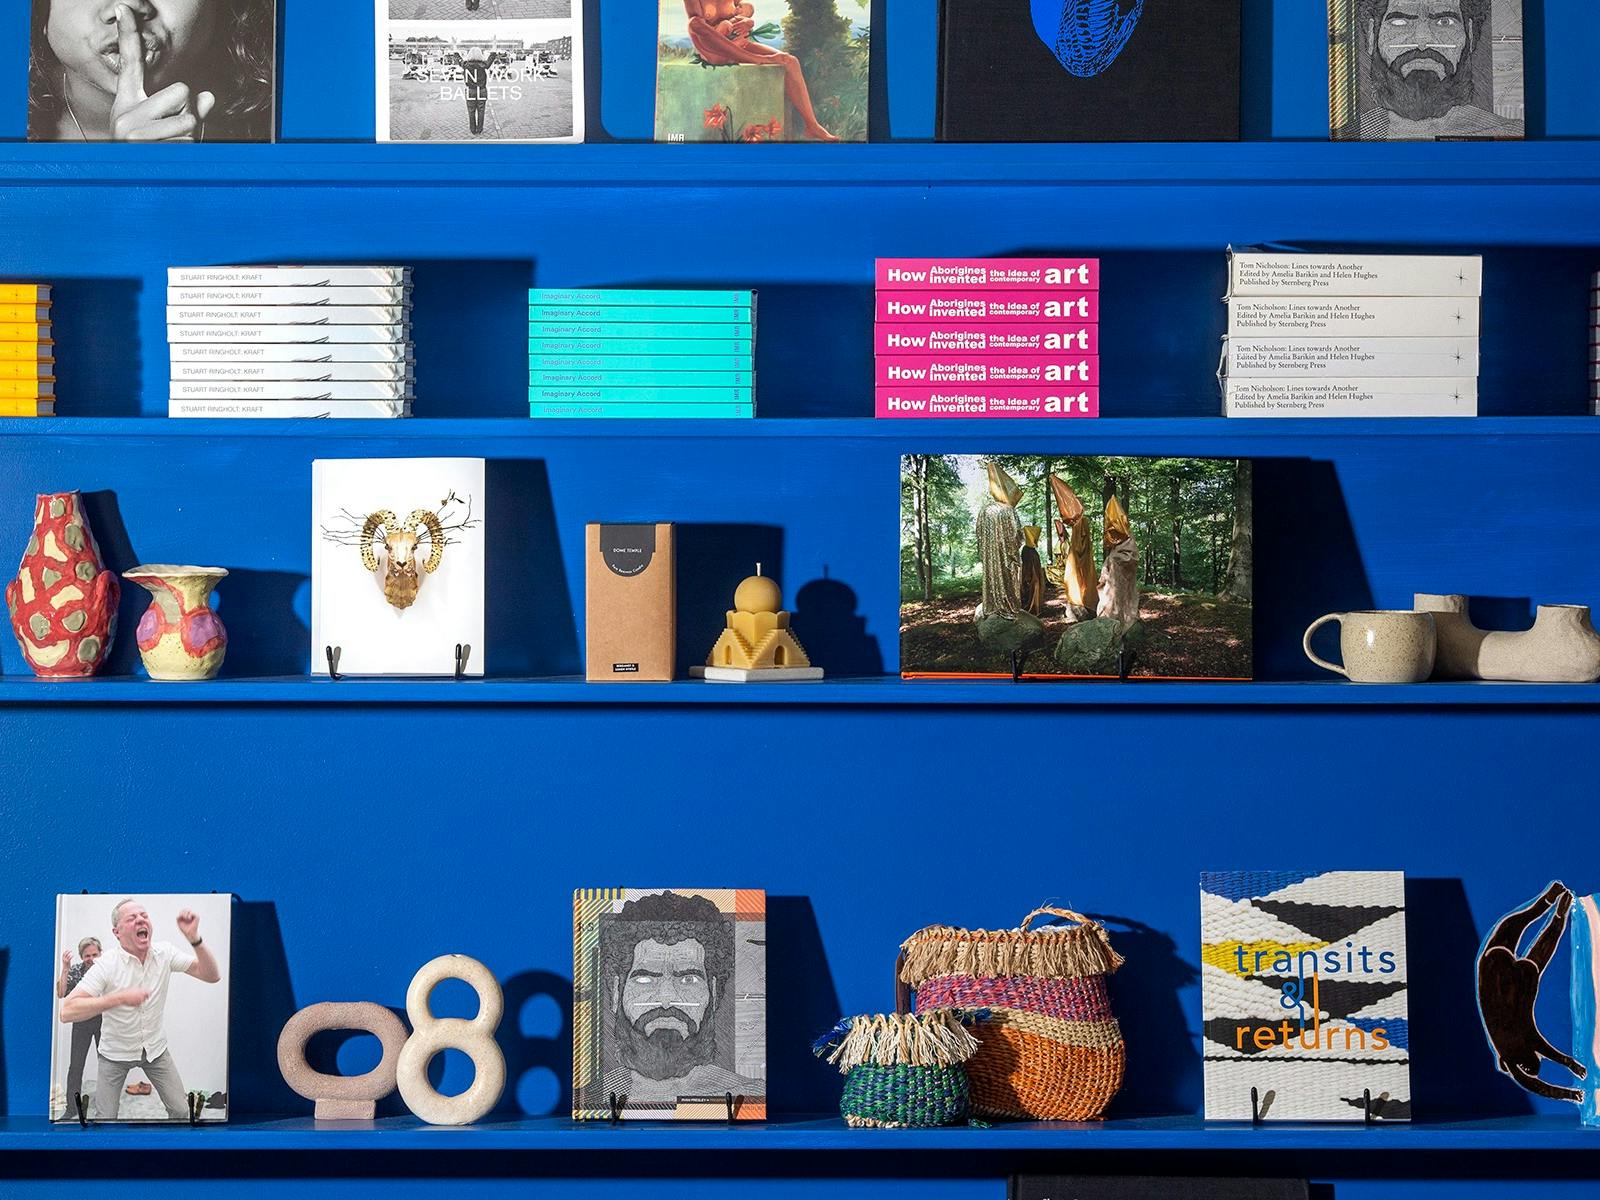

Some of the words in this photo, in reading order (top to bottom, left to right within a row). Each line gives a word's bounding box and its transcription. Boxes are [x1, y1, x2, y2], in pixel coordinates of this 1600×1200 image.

[417, 68, 478, 83] SEVEN
[485, 68, 545, 83] WORK
[440, 86, 522, 100] BALLETS
[888, 269, 926, 282] How
[930, 266, 986, 276] Aborigines
[1044, 264, 1088, 284] art
[1262, 271, 1270, 280] by
[1354, 272, 1378, 281] Hughes
[930, 274, 986, 284] invented
[1271, 279, 1279, 288] by
[1281, 279, 1311, 288] Sternberg
[888, 302, 926, 315] How
[930, 299, 986, 309] Aborigines
[1044, 297, 1088, 317] art
[929, 307, 986, 317] invented
[1259, 312, 1267, 321] by
[1351, 313, 1375, 322] Hughes
[1269, 320, 1276, 329] by
[1278, 321, 1308, 329] Sternberg
[888, 334, 926, 347] How
[930, 331, 986, 341] Aborigines
[1044, 329, 1088, 349] art
[929, 339, 986, 349] invented
[1259, 353, 1267, 362] by
[1351, 354, 1375, 362] Hughes
[930, 364, 986, 373] Aborigines
[1268, 361, 1276, 370] by
[1278, 362, 1308, 370] Sternberg
[888, 366, 926, 379] How
[930, 372, 986, 381] invented
[1044, 361, 1088, 382] art
[930, 395, 986, 404] Aborigines
[1044, 392, 1088, 413] art
[1257, 393, 1265, 402] by
[1349, 394, 1373, 402] Hughes
[888, 398, 926, 410] How
[930, 402, 986, 412] invented
[1267, 402, 1274, 410] by
[1276, 402, 1306, 410] Sternberg
[1234, 941, 1396, 973] transits
[1280, 982, 1304, 1009] &
[1236, 1020, 1388, 1050] returns
